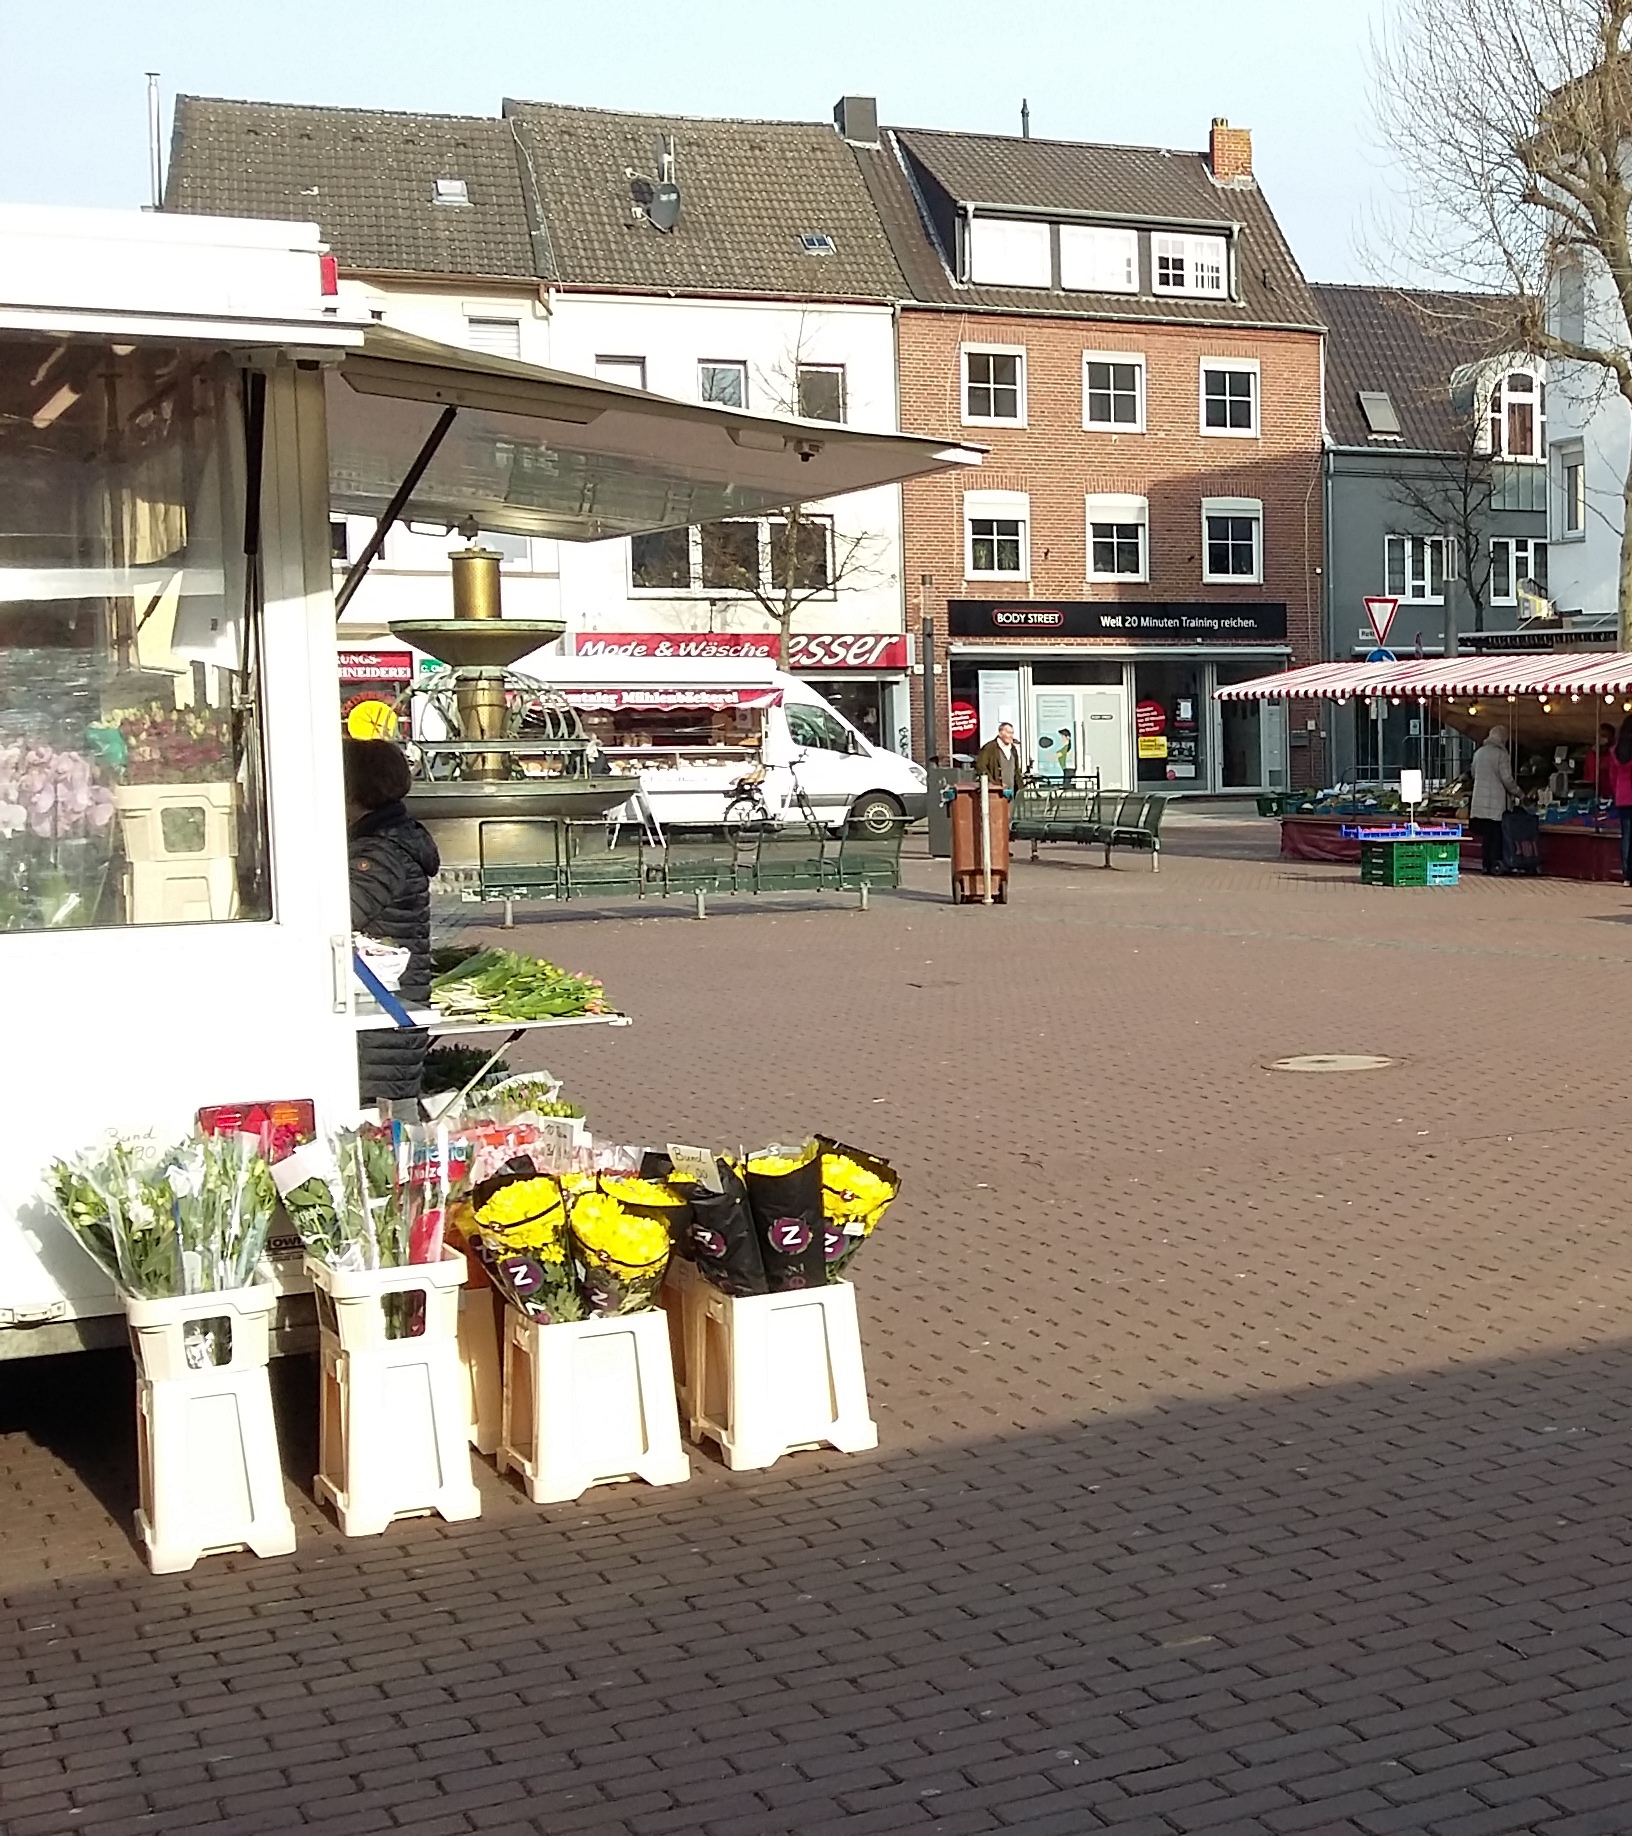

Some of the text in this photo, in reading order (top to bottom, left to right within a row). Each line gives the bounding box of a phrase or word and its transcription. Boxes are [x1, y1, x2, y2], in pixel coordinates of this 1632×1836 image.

[997, 613, 1060, 625] BODY STREET
[1100, 616, 1258, 631] Weil 20 Minuten Training reichen.
[578, 640, 770, 657] Mode & Wäsche
[672, 1146, 707, 1164] Bund
